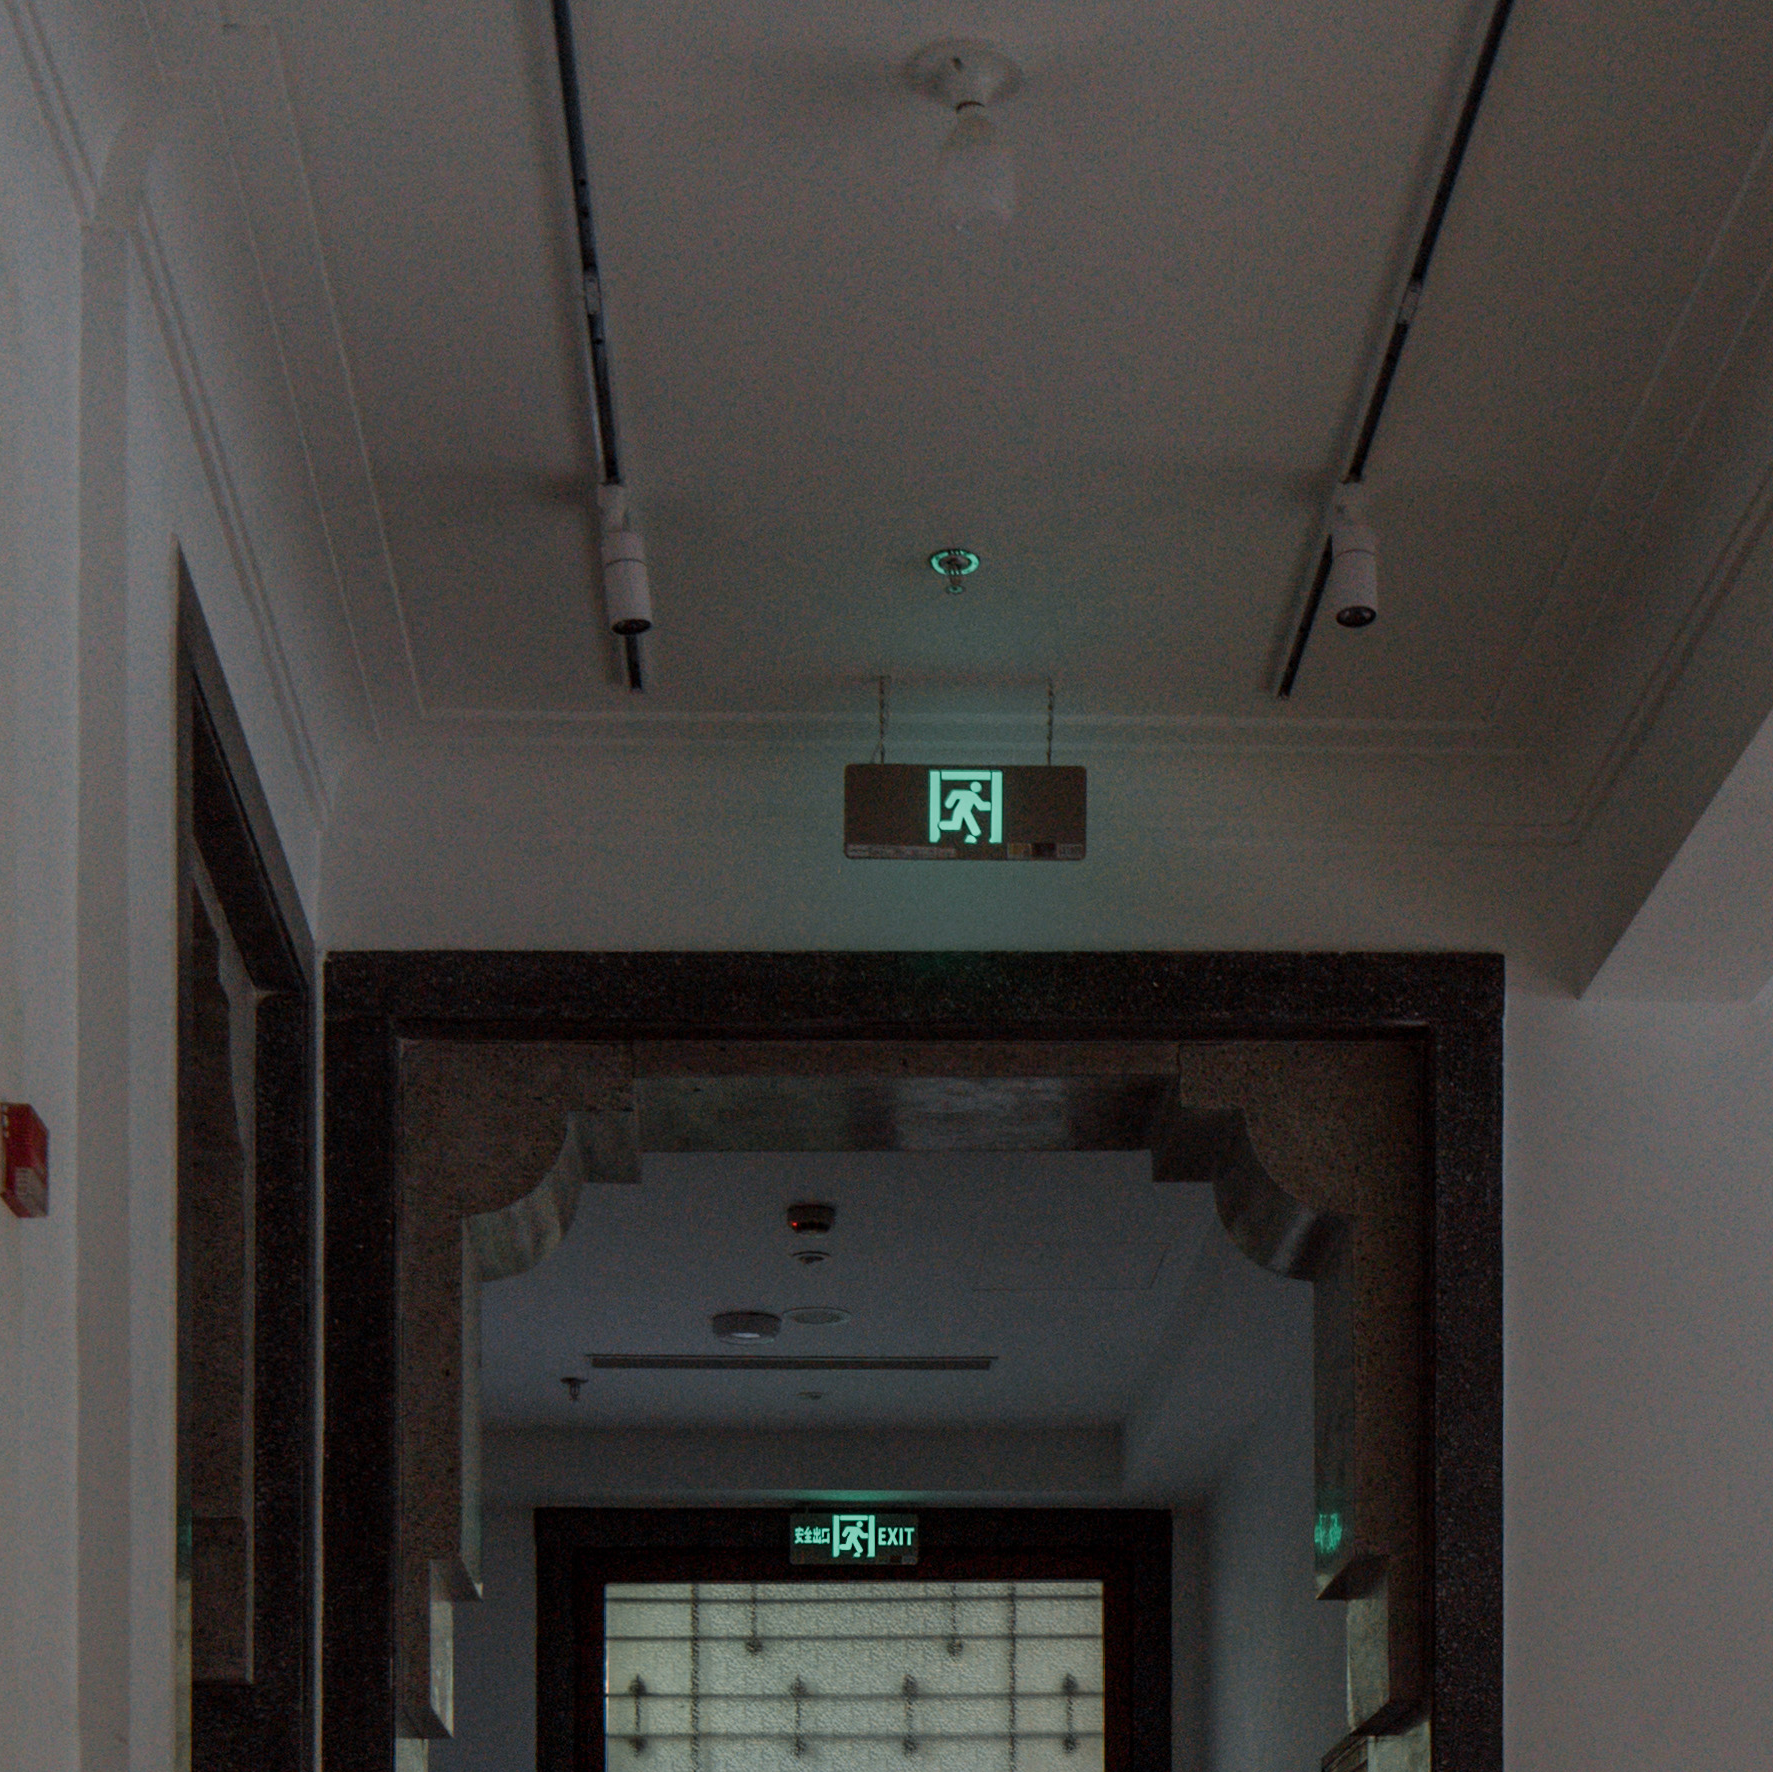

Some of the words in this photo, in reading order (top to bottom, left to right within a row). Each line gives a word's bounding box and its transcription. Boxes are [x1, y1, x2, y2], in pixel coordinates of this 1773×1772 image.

[794, 1526, 830, 1544] 安全出口
[878, 1527, 915, 1546] EXIT
